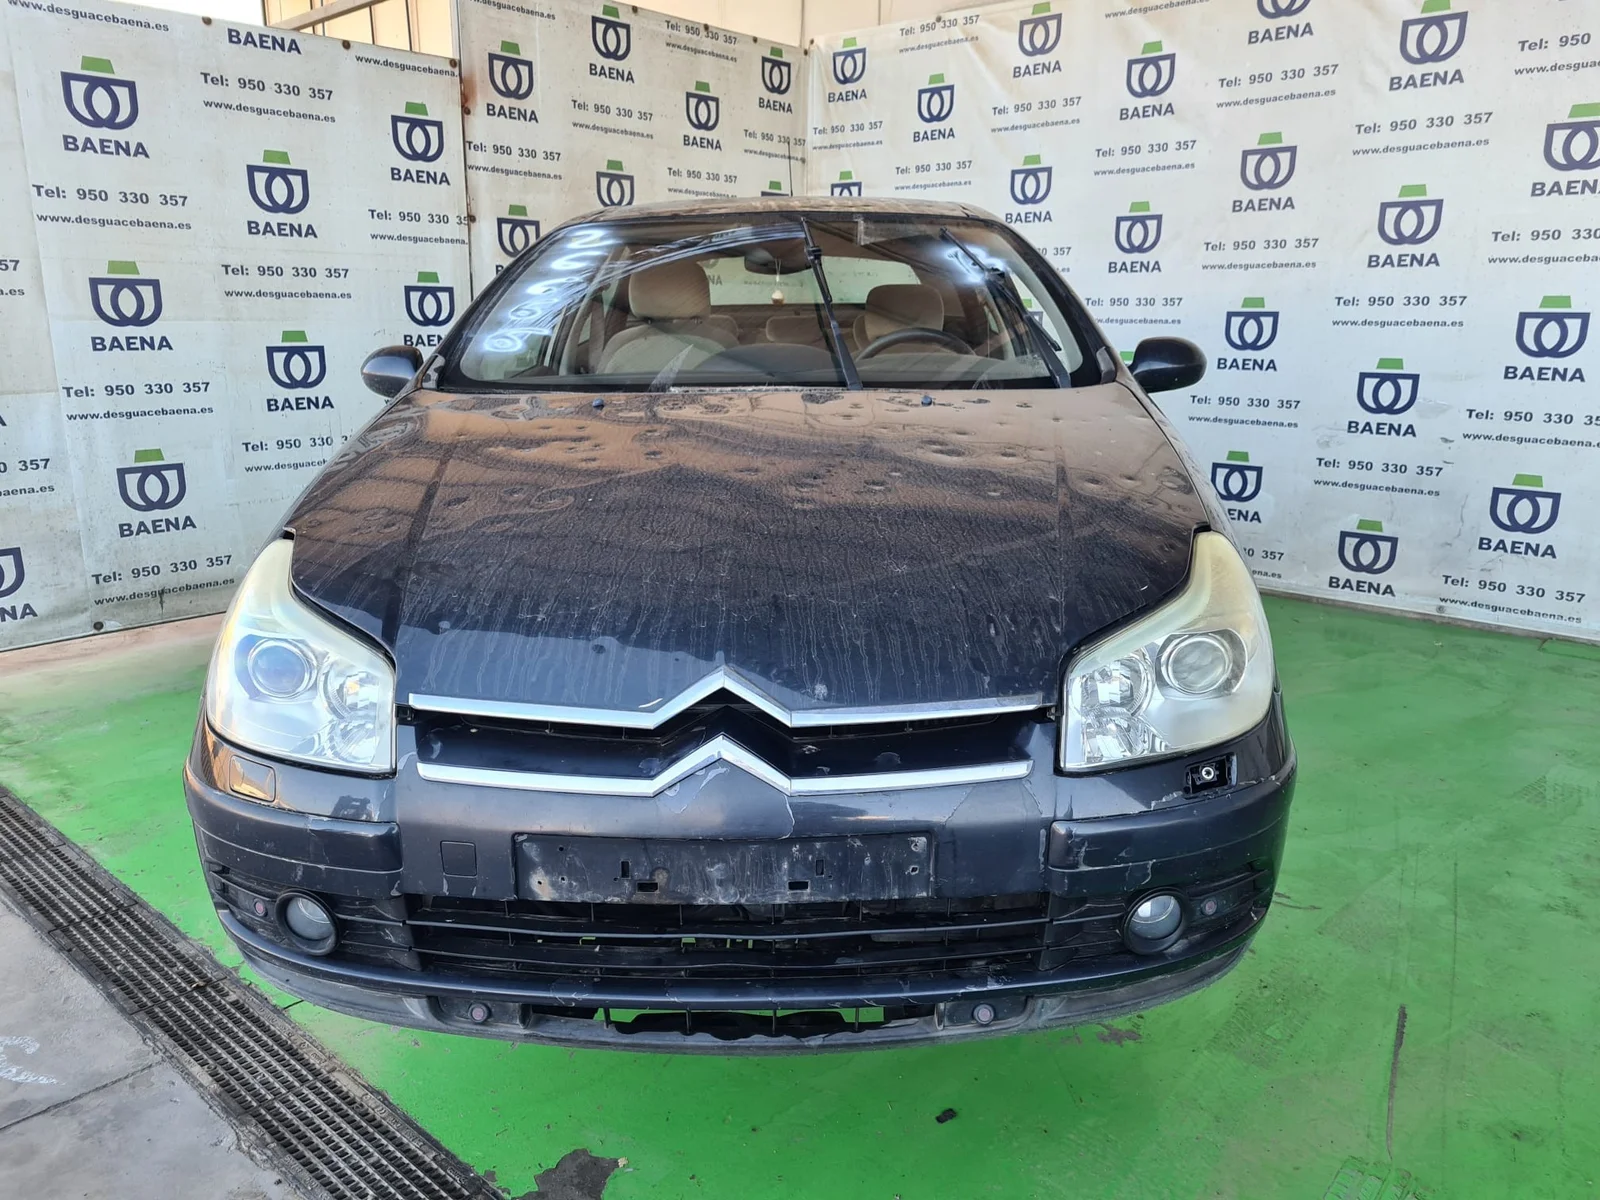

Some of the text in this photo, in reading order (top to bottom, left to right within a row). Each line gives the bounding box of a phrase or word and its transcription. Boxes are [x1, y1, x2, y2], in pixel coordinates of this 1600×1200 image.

[665, 20, 737, 45] Tel: 950 357
[900, 15, 980, 36] Tel: 950 330 357
[1248, 22, 1313, 44] BAENA
[227, 28, 302, 54] BAENA
[1518, 33, 1591, 51] Tel: 950
[589, 63, 634, 83] BAENA
[1013, 60, 1061, 78] BAENA
[1219, 64, 1338, 88] Tel: 950 330 357
[200, 72, 333, 100] Tel: 950 330 357
[1389, 69, 1464, 91] BAENA
[828, 89, 867, 103] BAENA
[1216, 90, 1335, 108] www.desguacebaena.es
[203, 100, 335, 123] www.desguacebaena.es
[487, 103, 538, 123] BAENA
[571, 99, 653, 121] Tel: 950 330 357
[759, 97, 792, 114] BAENA
[992, 96, 1081, 115] Tel: 950 330 357
[1120, 103, 1174, 120] BAENA
[813, 121, 883, 135] Tel: 950 330 357
[1355, 112, 1493, 134] Tel: 950 330 357
[684, 135, 722, 151] BAENA
[913, 128, 955, 142] BAENA
[63, 135, 149, 158] BAENA
[467, 140, 561, 161] Tel: 950 330 357
[1096, 140, 1196, 157] Tel: 950 330 357
[1353, 139, 1489, 155] www.desguacebaena.es
[467, 163, 562, 180] www.desguacebaena.es
[667, 167, 737, 183] Tel: 950 330 357
[896, 160, 972, 175] Tel: 950 330 357
[1094, 163, 1195, 176] www.desguacebaena.es
[391, 167, 450, 185] BAENA
[32, 184, 187, 206] Tel: 950 330 357
[1232, 197, 1295, 212] BAENA
[36, 214, 191, 230] www.desguacebaena.es
[368, 209, 449, 224] Tel: 950 330
[1006, 211, 1052, 223] BAENA
[247, 221, 317, 238] BAENA
[1492, 230, 1561, 241] Tel: 950
[1054, 247, 1071, 256] 357
[1204, 238, 1319, 251] Tel: 950 330 357
[1109, 261, 1161, 273] BAENA
[1202, 261, 1316, 271] www.desguacebaena.es
[1368, 253, 1440, 268] BAENA
[221, 264, 348, 278] Tel: 950 330 357
[224, 289, 351, 299] www.desguacebaena.es
[1085, 298, 1182, 306] Tel: 950 330 357
[1335, 296, 1467, 306] Tel: 950 330 357
[1332, 319, 1463, 328] www.desguacebaena.es
[91, 336, 173, 351] BAENA
[1217, 358, 1277, 371] BAENA
[1504, 366, 1585, 382] BAENA
[62, 382, 210, 397] Tel: 950 330 357
[267, 396, 334, 411] BAENA
[1190, 395, 1300, 409] Tel: 950 330 357
[66, 407, 213, 420] www.desguacebaena.es
[1466, 409, 1573, 424] Tel: 950 330
[1188, 416, 1298, 428] www.desguacebaena.es
[1347, 421, 1416, 437] BAENA
[242, 441, 268, 452] Tel:
[276, 439, 301, 449] 950
[310, 436, 333, 447] 330
[18, 458, 50, 471] 357
[1316, 458, 1443, 476] Tel: 950 330 357
[1314, 480, 1439, 496] www.desguacebaena.es
[119, 516, 197, 538] BAENA
[1262, 550, 1284, 561] 357
[1478, 537, 1556, 559] BAENA
[92, 555, 232, 584] Tel: 950 330 357
[1329, 576, 1395, 597] BAENA
[1443, 575, 1585, 603] Tel: 950 330 357
[1439, 597, 1583, 623] www.desguacebaena.es
